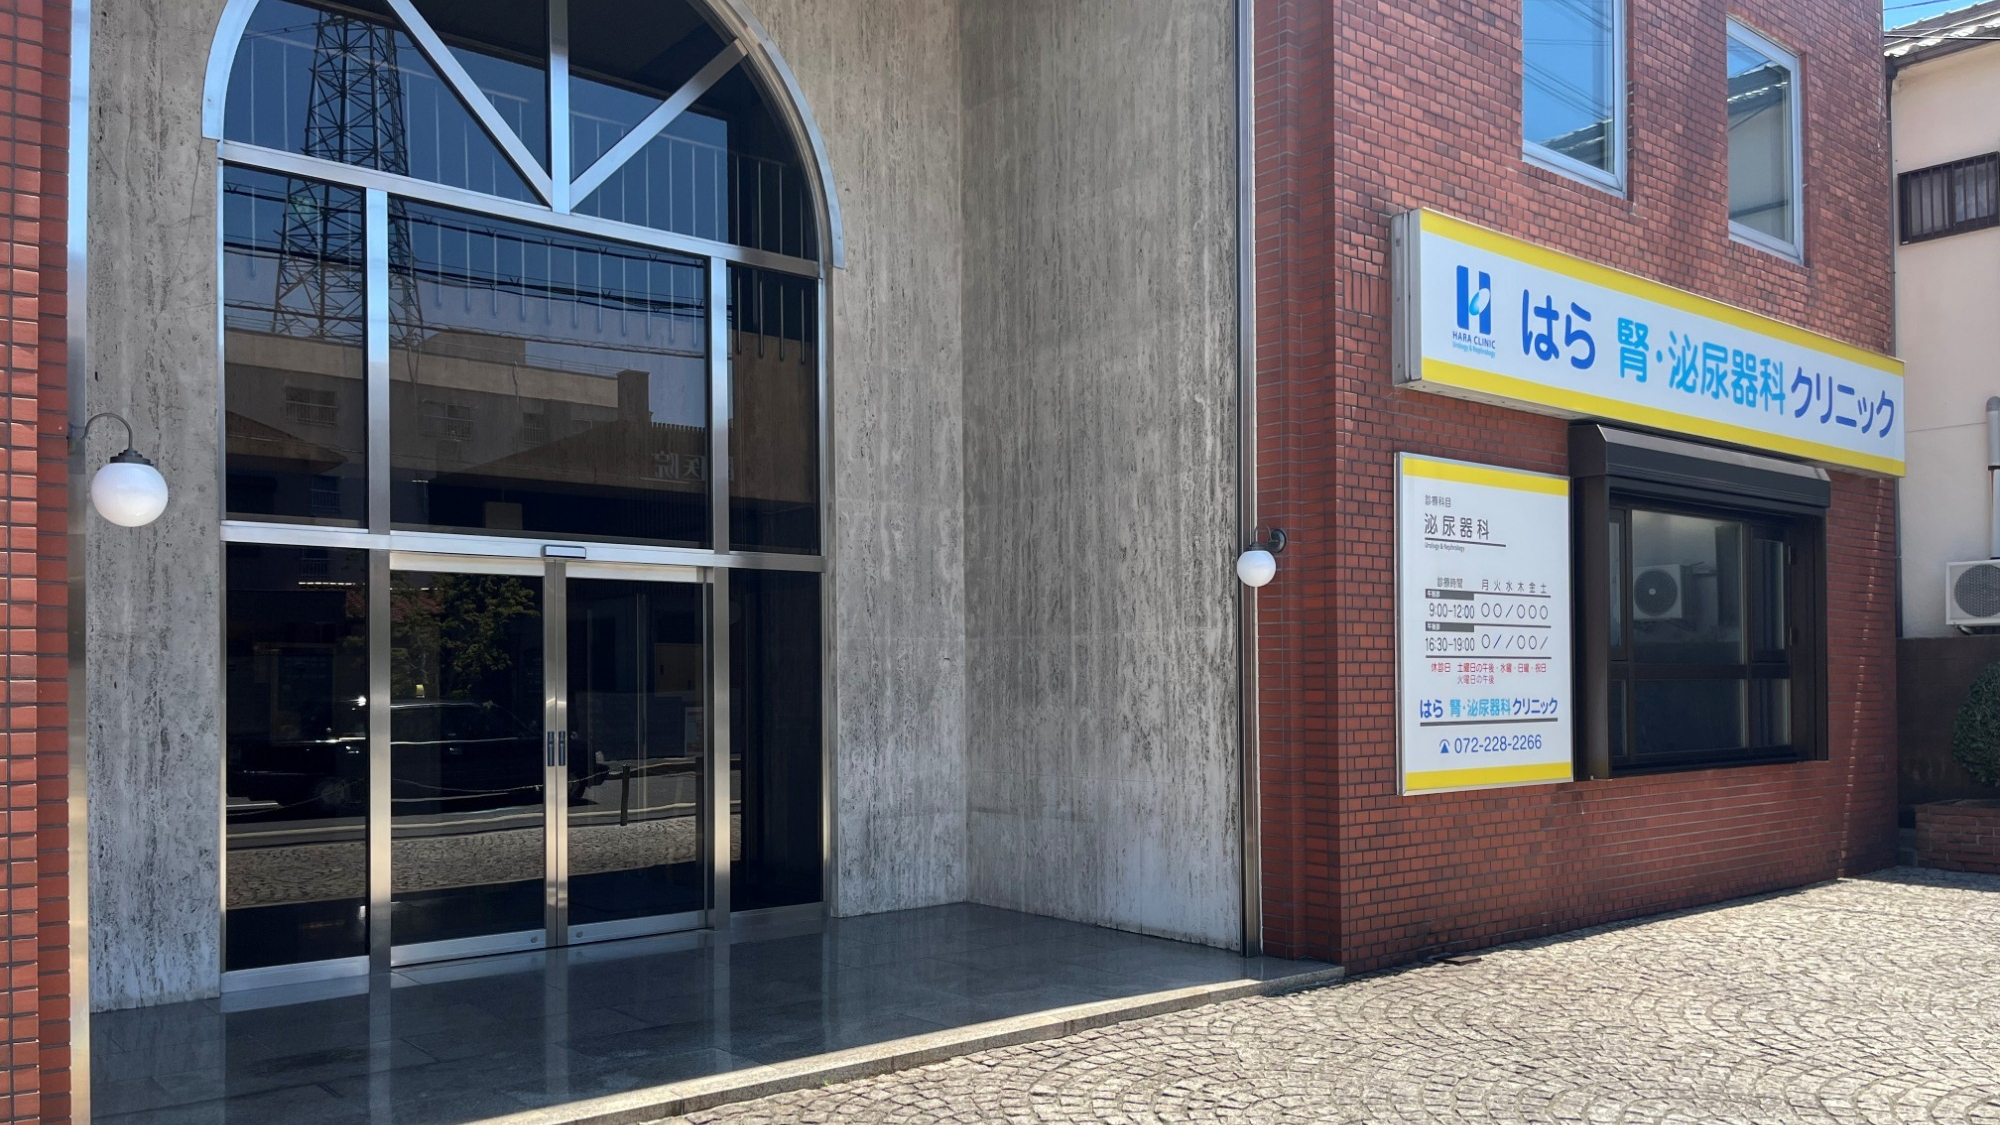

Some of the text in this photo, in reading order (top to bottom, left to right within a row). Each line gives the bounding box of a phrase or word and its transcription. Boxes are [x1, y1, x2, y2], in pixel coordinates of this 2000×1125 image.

[1452, 331, 1496, 350] HARA CLINIC
[1521, 289, 1596, 370] はら
[1790, 366, 1895, 438] クリニック
[1424, 494, 1451, 508] 診療科目
[1424, 513, 1490, 540] 泌尿器科
[1481, 579, 1489, 591] 月
[1493, 580, 1501, 592] 火
[1505, 581, 1513, 592] 水
[1517, 582, 1525, 592] 木
[1529, 582, 1536, 593] 金
[1540, 583, 1547, 594] 土
[1429, 602, 1475, 619] 9:00-12:00
[1425, 637, 1475, 652] 16:30-19:00
[1457, 674, 1495, 685] 火曜日の午後
[1420, 699, 1444, 719] はら
[1512, 697, 1558, 715] クリニック
[1454, 734, 1542, 754] 072-228-2266
